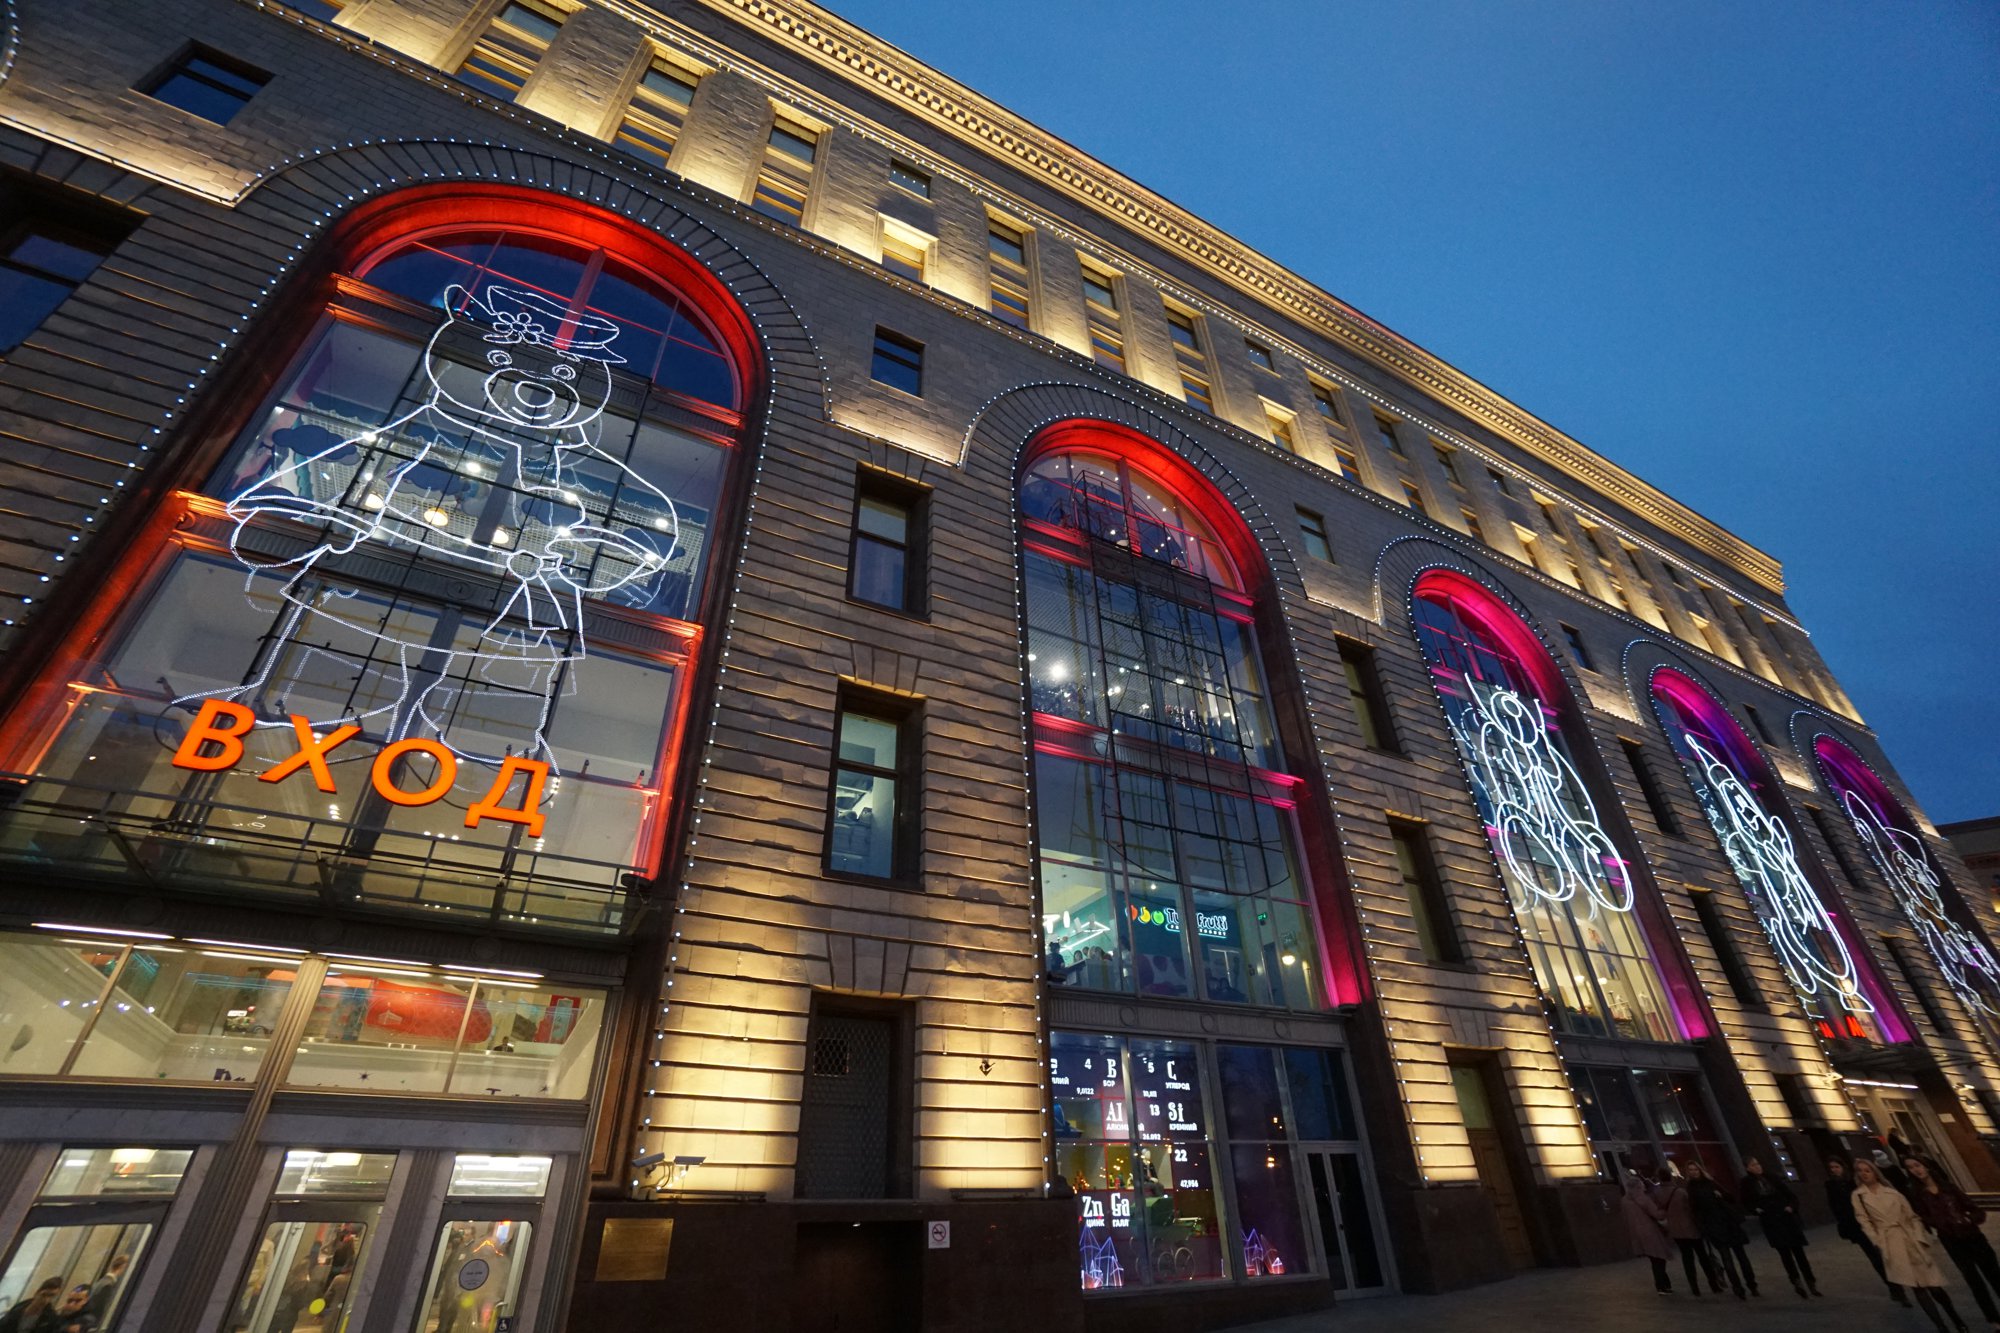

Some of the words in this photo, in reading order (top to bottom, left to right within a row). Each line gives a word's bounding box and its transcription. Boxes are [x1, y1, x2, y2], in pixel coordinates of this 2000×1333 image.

[172, 698, 551, 838] ВХОД
[1084, 1058, 1092, 1069] 4
[1106, 1058, 1117, 1078] B
[1147, 1062, 1155, 1073] 5
[1166, 1060, 1177, 1081] C
[1102, 1079, 1116, 1087] БОР
[1165, 1081, 1191, 1091] УГЛЕРОД
[1106, 1101, 1123, 1121] Al
[1149, 1104, 1160, 1116] 13
[1167, 1101, 1185, 1122] Si
[1168, 1122, 1198, 1132] КРЕМНИЙ
[1174, 1149, 1188, 1162] 22
[1082, 1195, 1104, 1218] Zn
[1111, 1192, 1131, 1217] Ga
[1086, 1218, 1105, 1228] ЦИНК
[1112, 1218, 1130, 1228] ГАЛЛ
